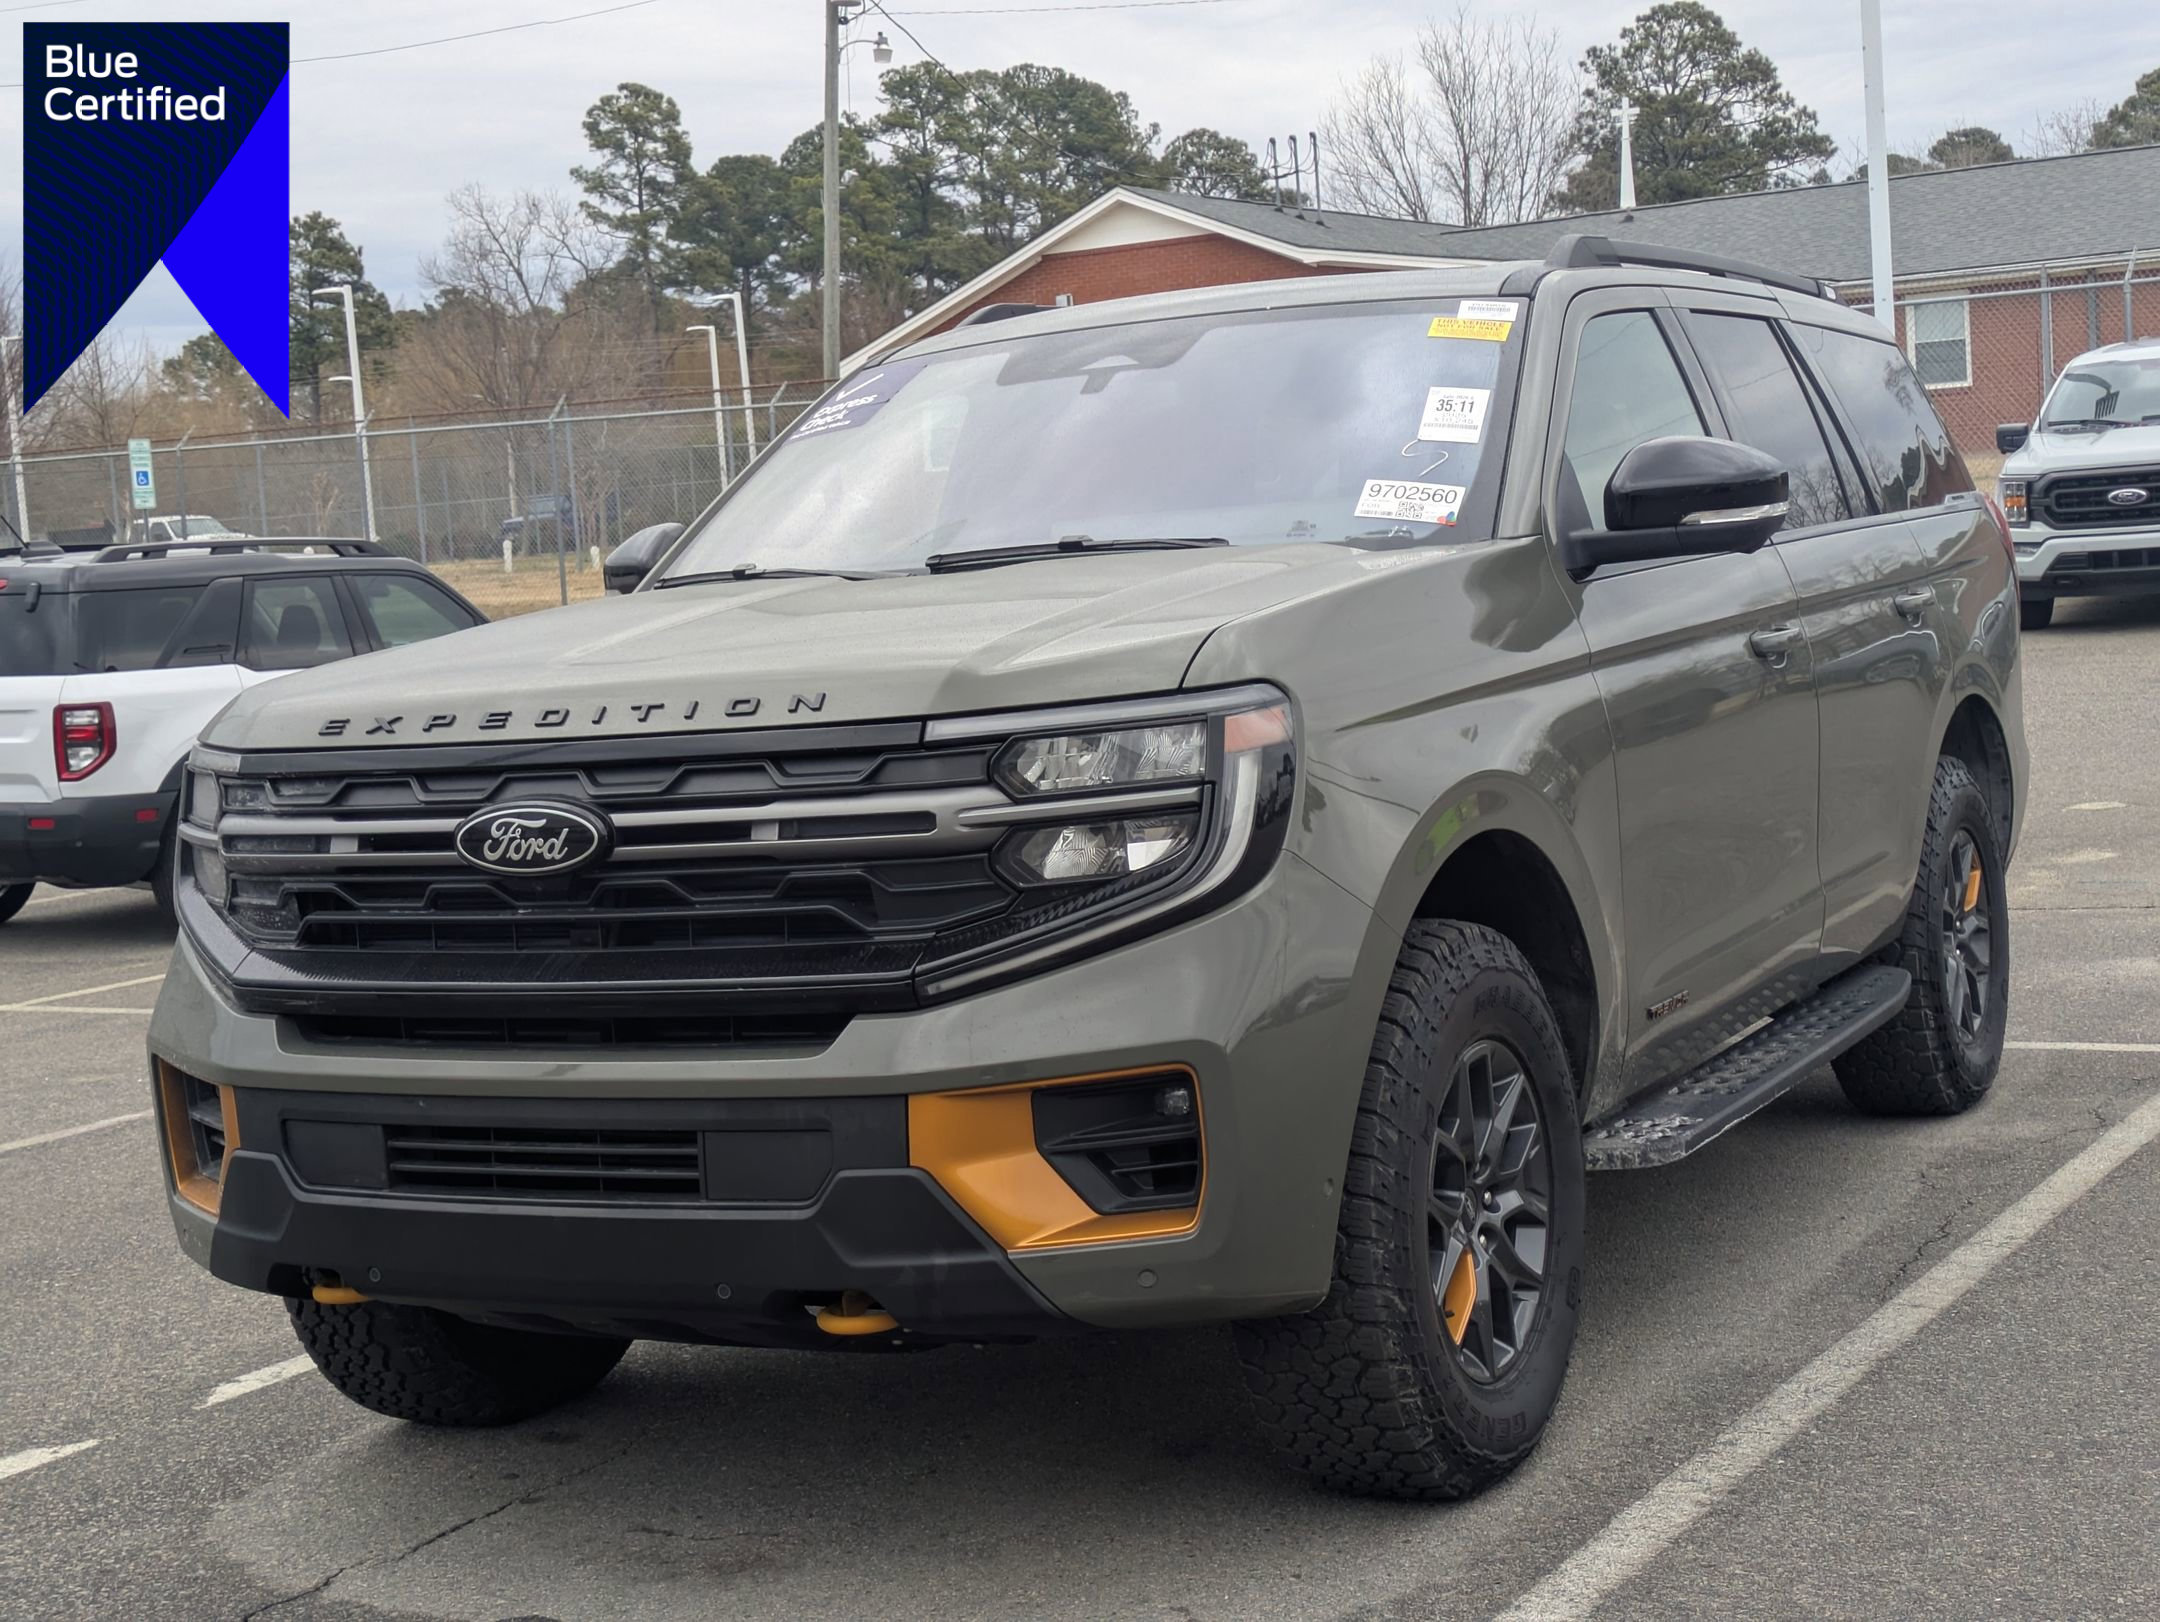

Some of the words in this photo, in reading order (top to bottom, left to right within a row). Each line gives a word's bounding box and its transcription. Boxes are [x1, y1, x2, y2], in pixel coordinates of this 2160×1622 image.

[1436, 398, 1475, 414] 35:11
[1368, 483, 1458, 504] 9702560
[318, 691, 828, 738] EXPEDITION
[482, 817, 570, 861] Ford
